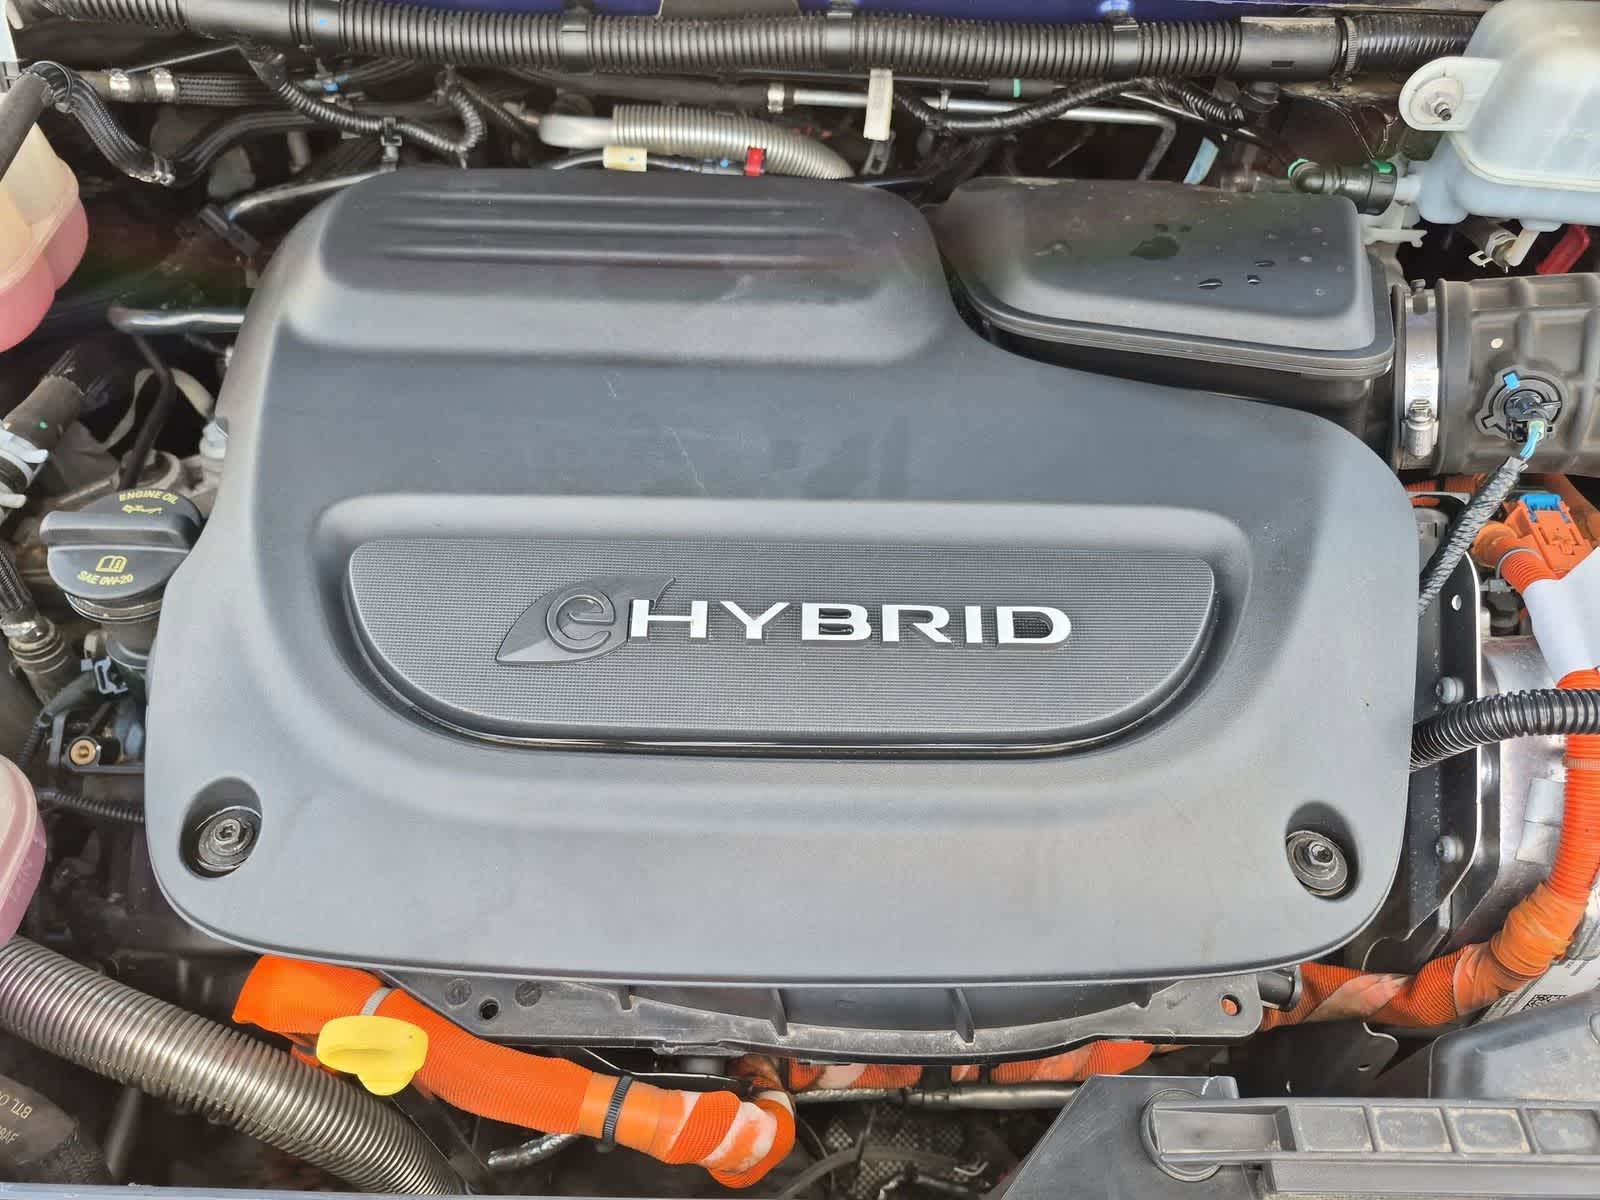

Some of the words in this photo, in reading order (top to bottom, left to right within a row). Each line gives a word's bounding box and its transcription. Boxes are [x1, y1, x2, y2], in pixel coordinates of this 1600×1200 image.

[120, 490, 161, 501] ENGINE
[162, 493, 178, 504] OIL
[78, 571, 99, 584] SAE
